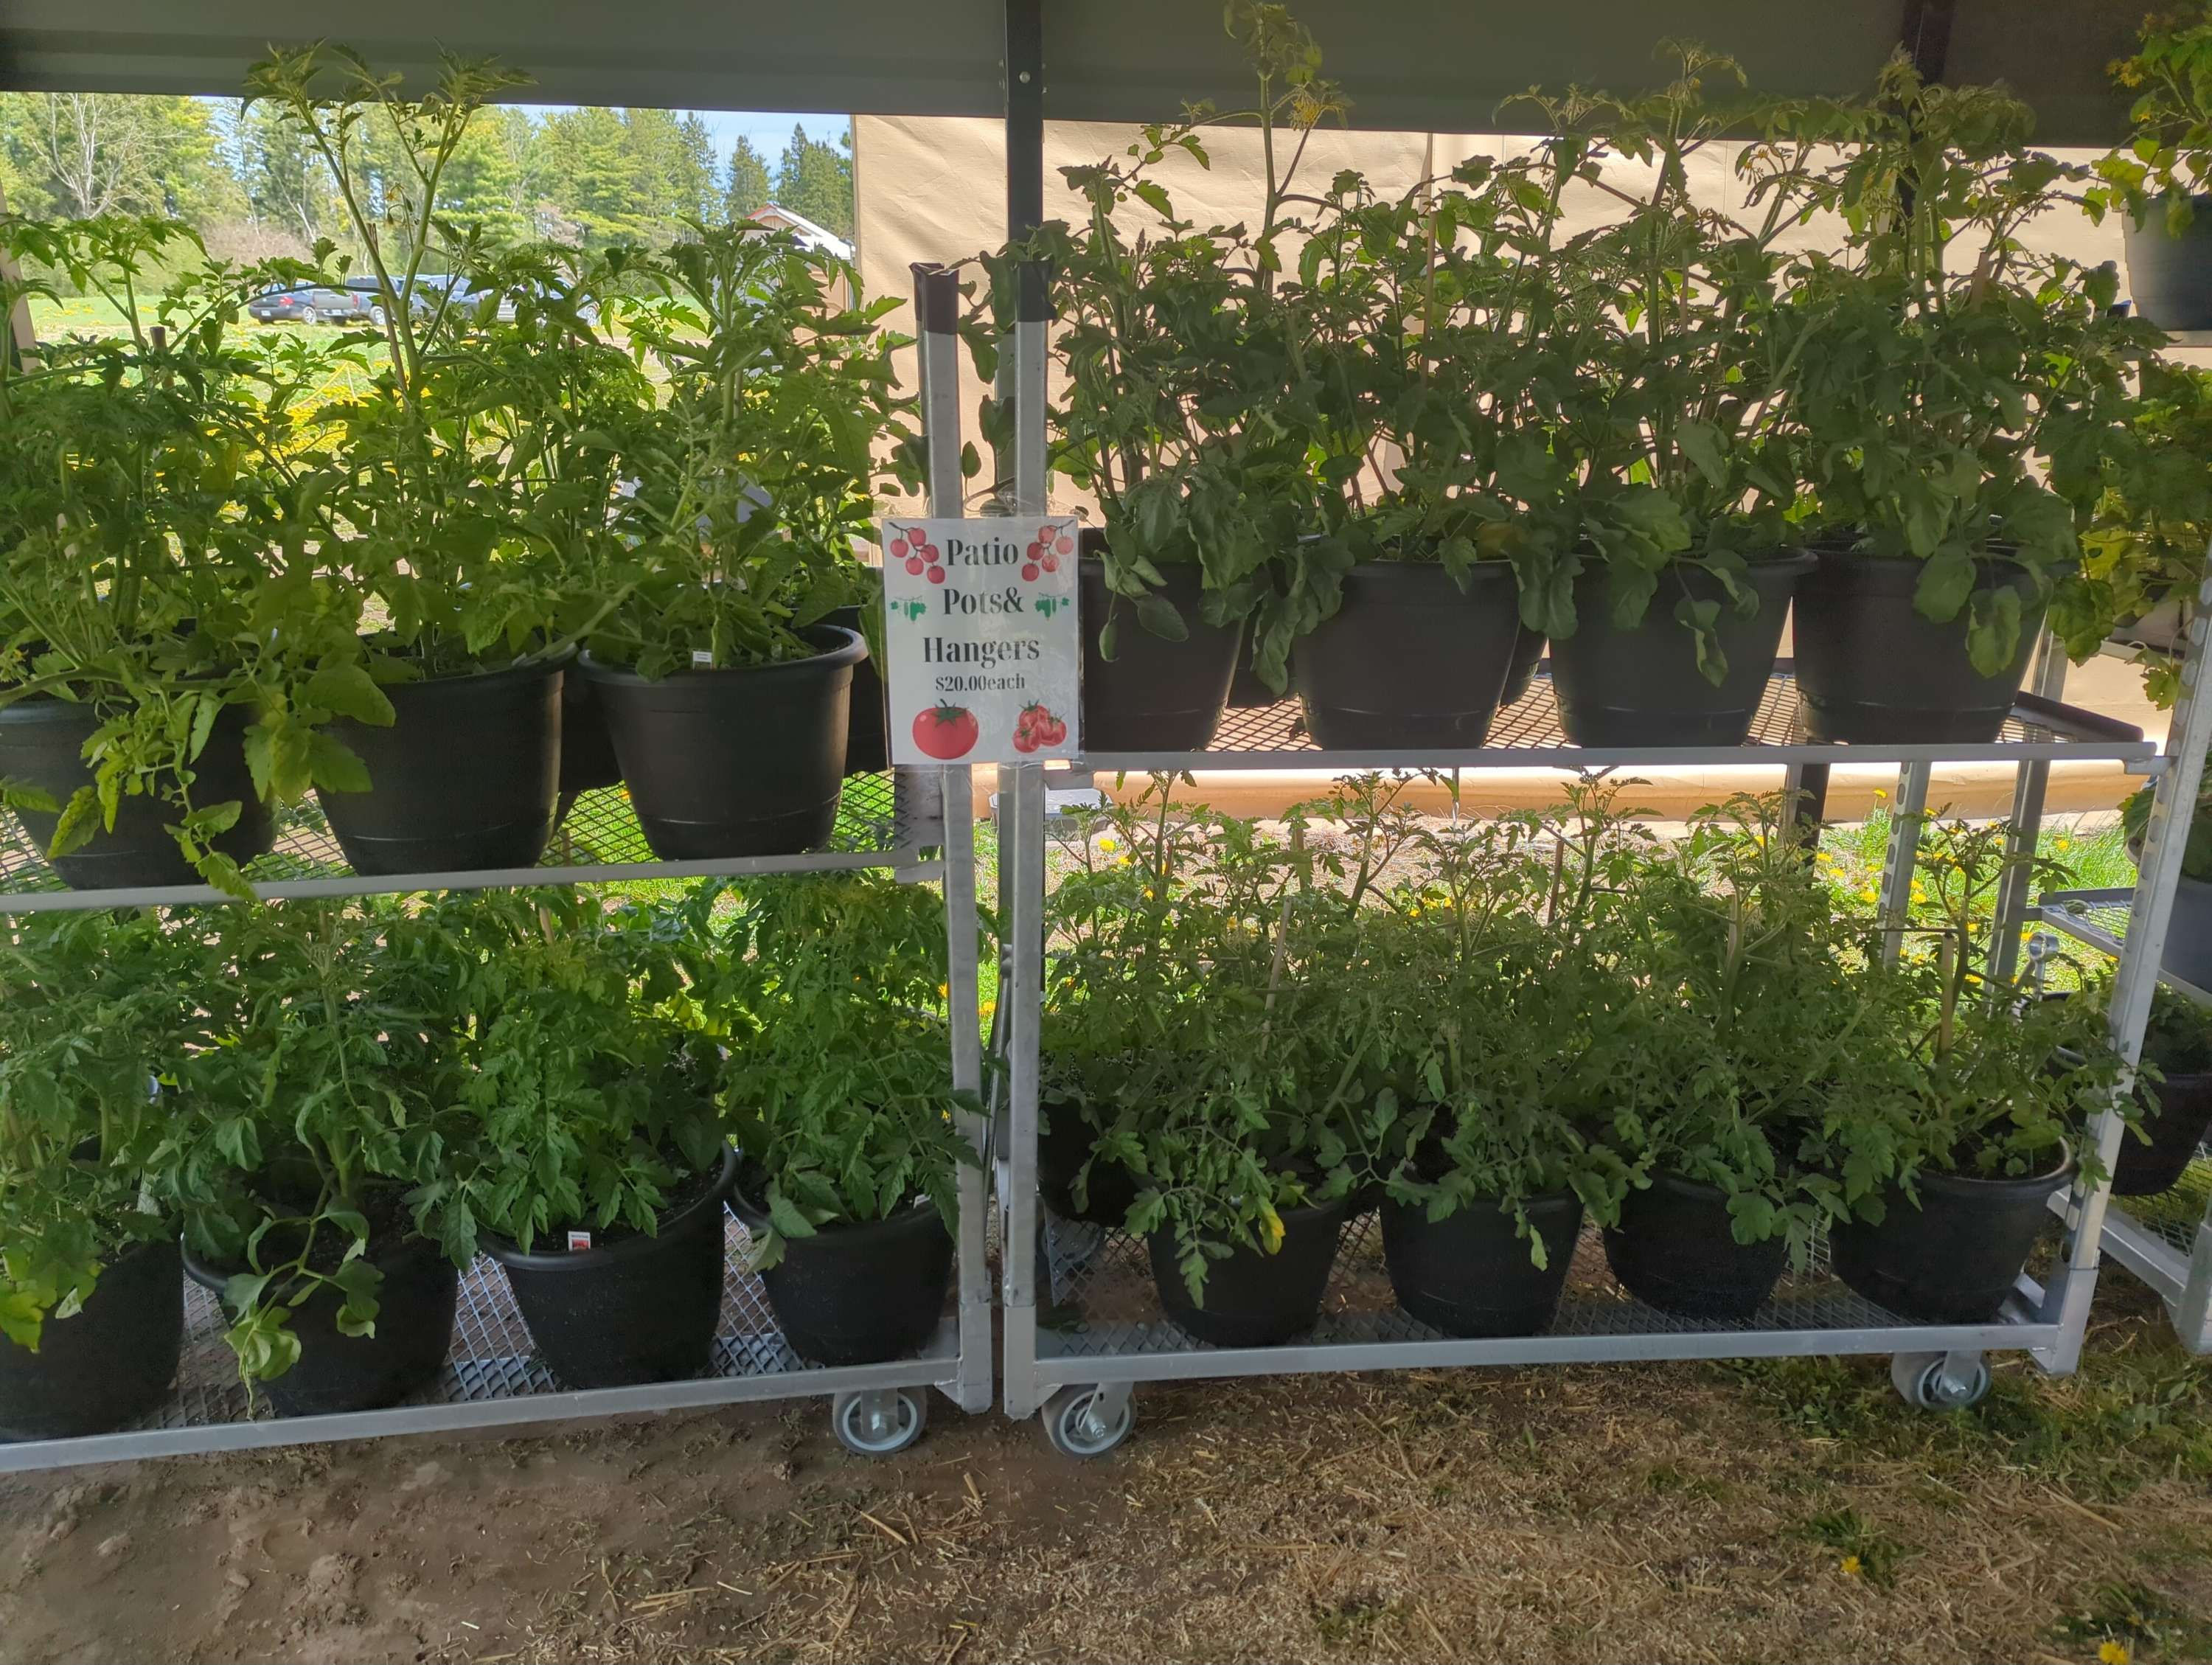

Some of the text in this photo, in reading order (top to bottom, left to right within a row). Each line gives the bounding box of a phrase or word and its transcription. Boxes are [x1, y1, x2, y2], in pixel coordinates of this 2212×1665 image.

[946, 537, 1018, 566] Patio
[943, 586, 1024, 615] Pots&
[923, 637, 1040, 670] Hangers
[935, 672, 1026, 692] $20.00each
